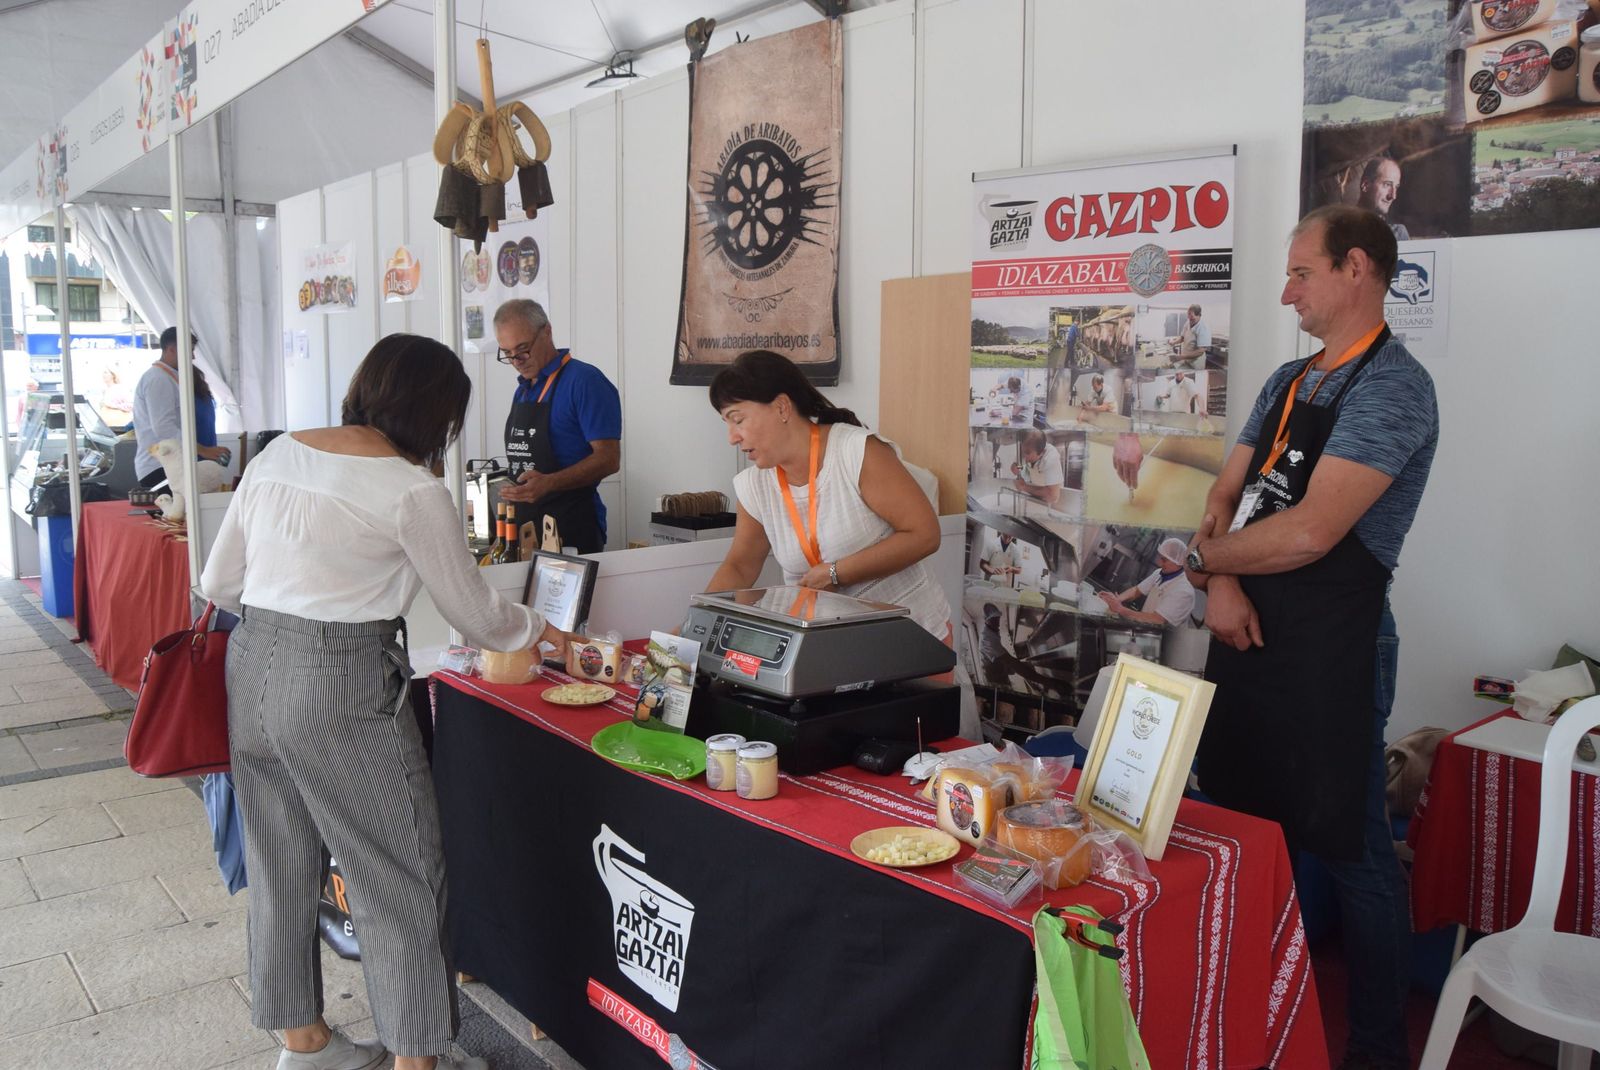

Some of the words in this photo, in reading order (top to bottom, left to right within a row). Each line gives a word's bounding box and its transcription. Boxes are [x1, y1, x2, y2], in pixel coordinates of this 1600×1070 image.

[204, 30, 221, 64] 027
[744, 123, 756, 140] DE
[757, 122, 802, 159] ARIBAYOS
[991, 216, 1033, 232] ARTZAI
[1045, 181, 1230, 243] GAZPIO
[990, 227, 1030, 246] GAZTA
[997, 262, 1121, 287] IDIAZABAL
[1174, 263, 1230, 274] BASERRIKOA
[1387, 318, 1433, 327] RTESANOS
[697, 333, 821, 351] www.abadiadearibayos.es
[1126, 748, 1143, 760] GOLD
[616, 902, 684, 961] ARTZAI
[616, 928, 680, 988] GAZTA
[601, 994, 666, 1050] IDIAZABAL
